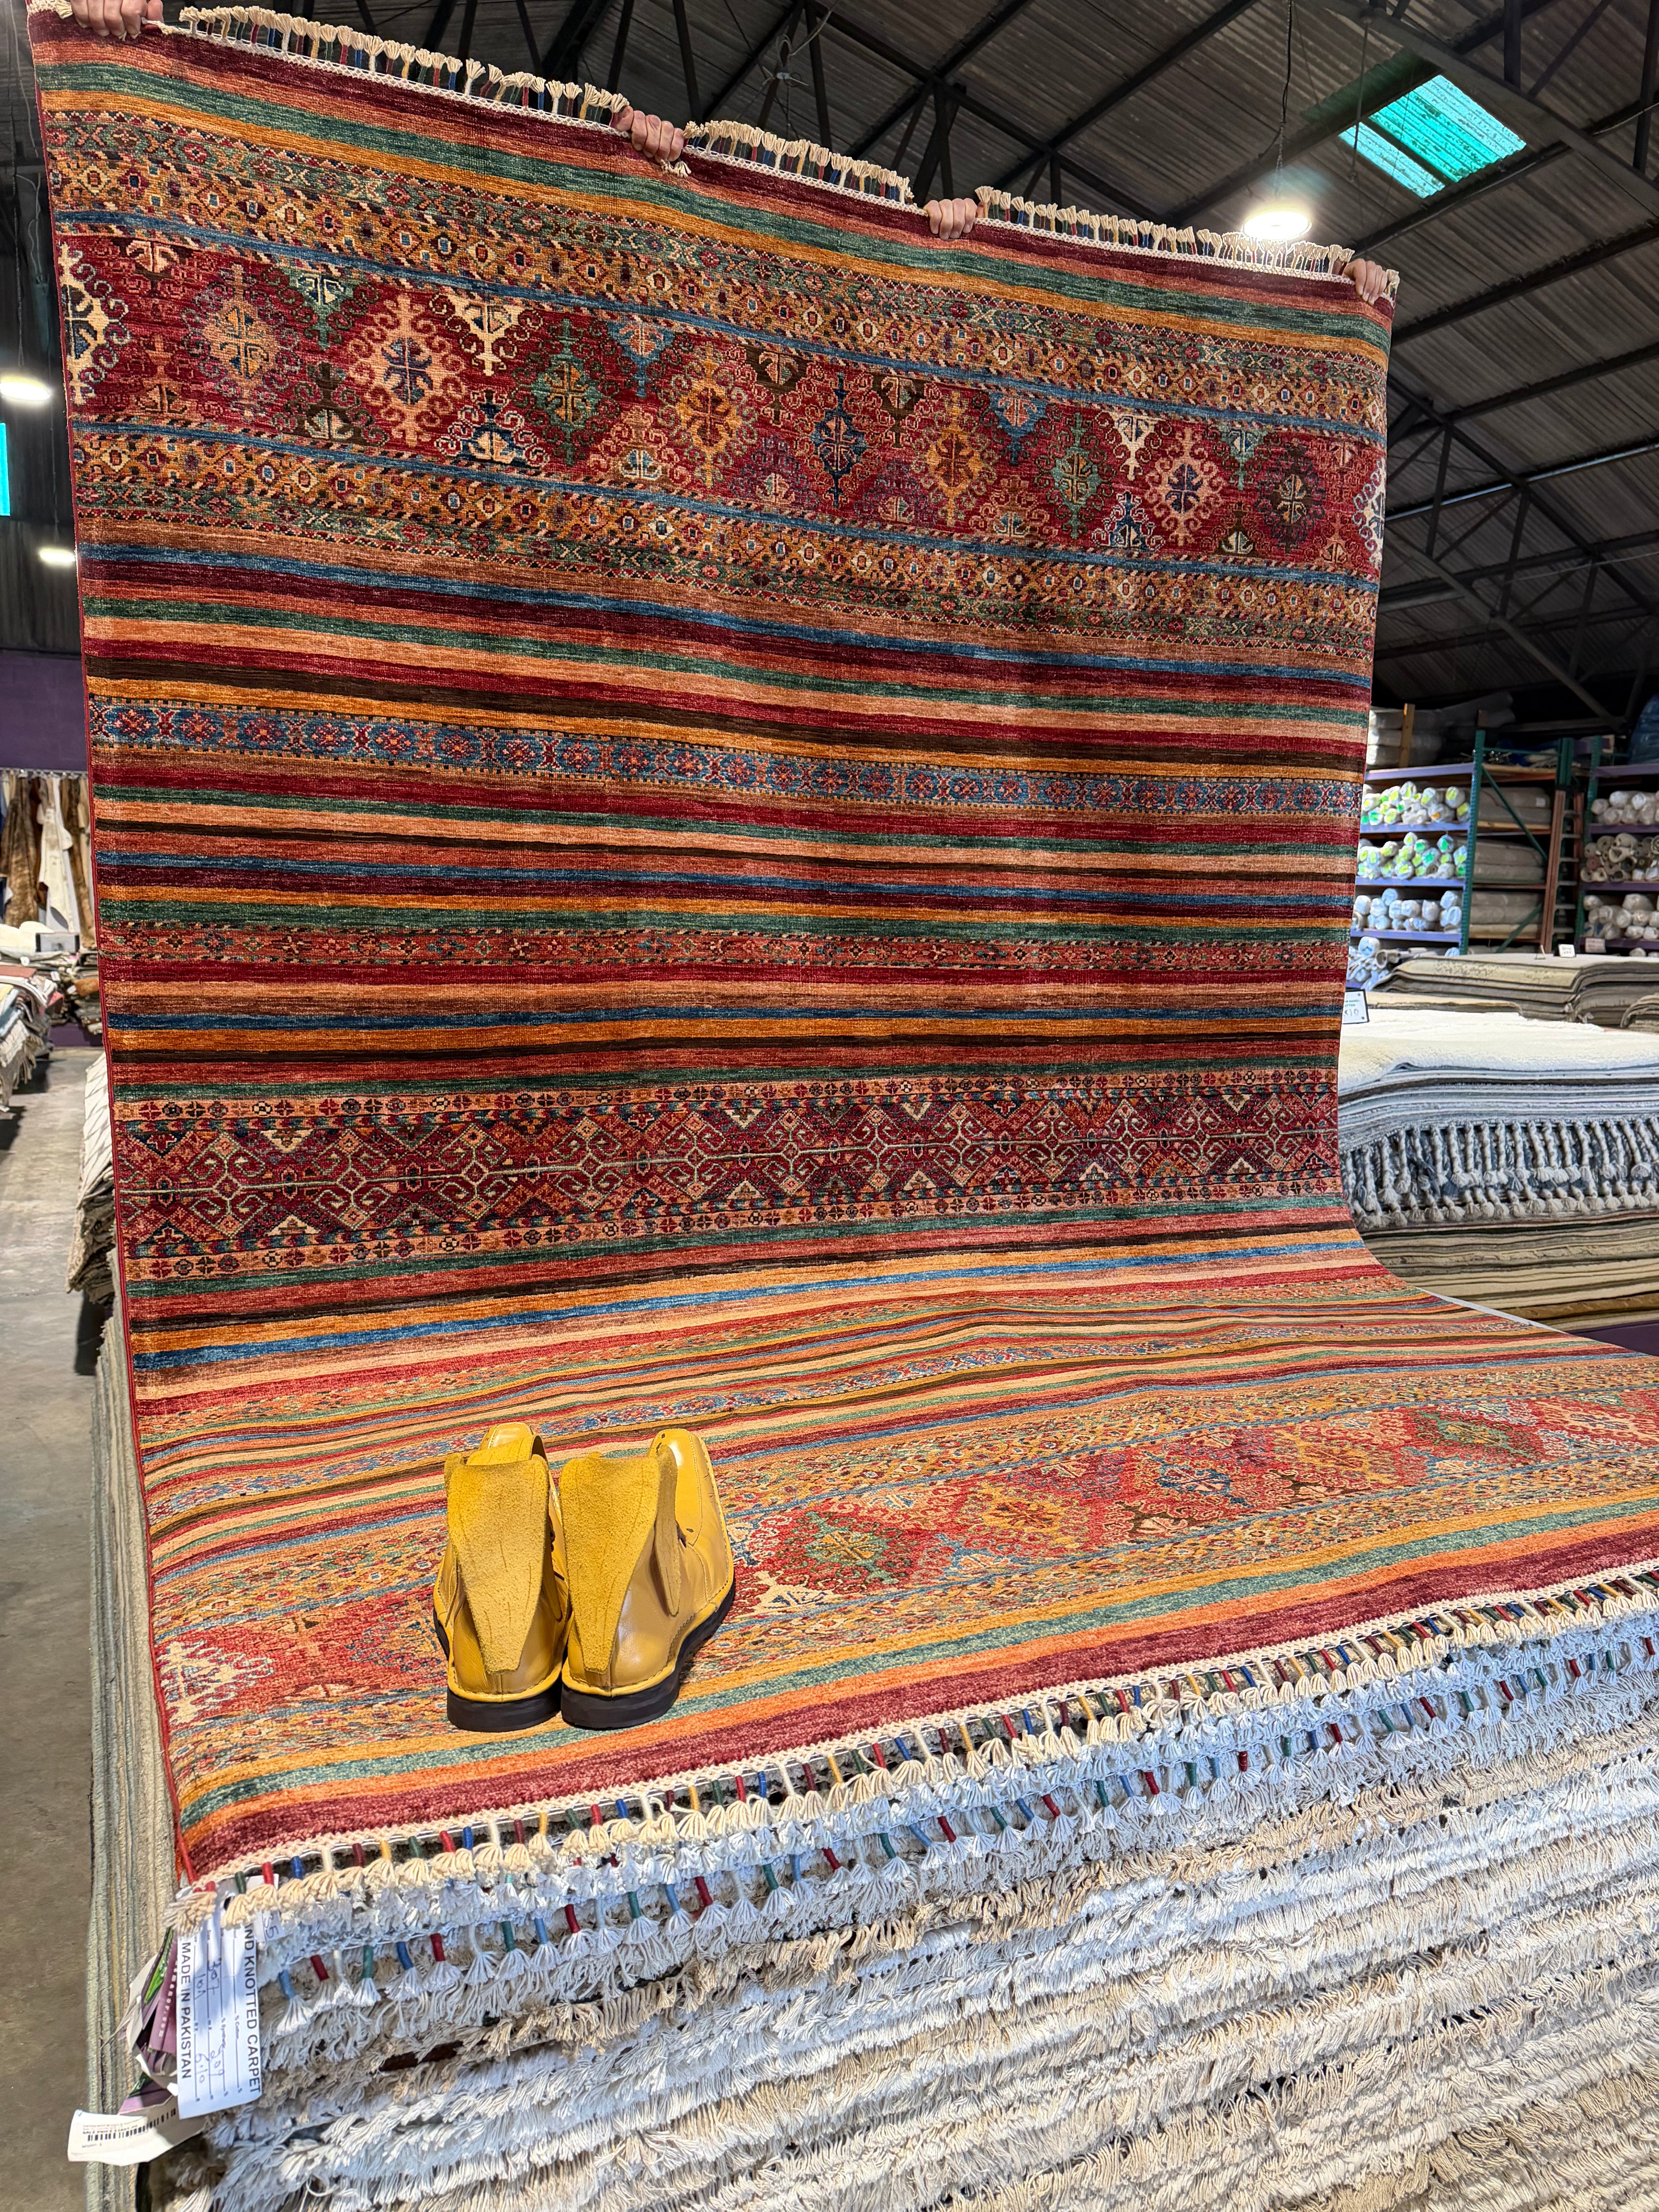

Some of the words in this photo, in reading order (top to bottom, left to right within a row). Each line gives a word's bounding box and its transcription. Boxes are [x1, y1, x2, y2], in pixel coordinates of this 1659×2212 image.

[180, 1942, 191, 1985] MADE
[244, 1956, 257, 2029] KNOTTED
[180, 1989, 191, 2002] IN
[180, 2007, 191, 2079] PAKISTAN
[247, 2034, 260, 2093] CARPET
